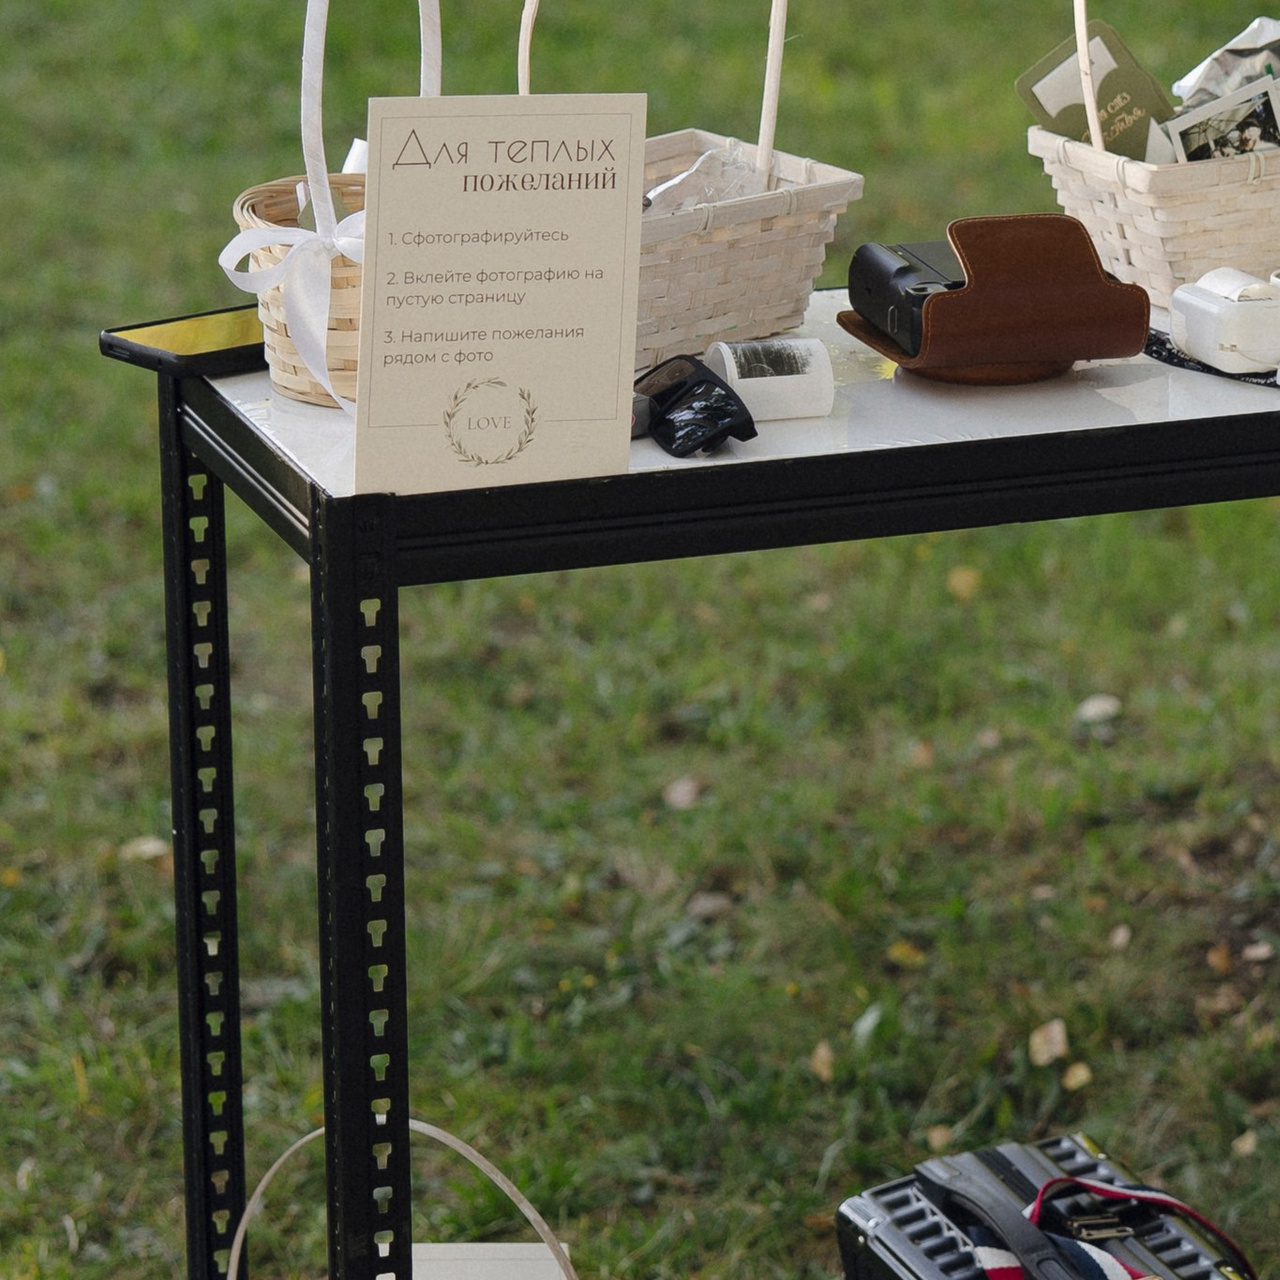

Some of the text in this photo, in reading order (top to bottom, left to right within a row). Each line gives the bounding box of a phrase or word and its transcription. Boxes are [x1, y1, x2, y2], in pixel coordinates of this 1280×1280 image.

[391, 128, 616, 171] Для теплых
[463, 166, 616, 192] пожеланий
[388, 228, 569, 248] 1. Сфотографируйтесь
[386, 267, 604, 286] 2. Вклейте фотографию на
[386, 292, 526, 309] пустую страницу
[383, 327, 585, 344] 3. Напишите пожелания
[383, 349, 494, 368] рядом с фото
[467, 416, 511, 431] LOVE
